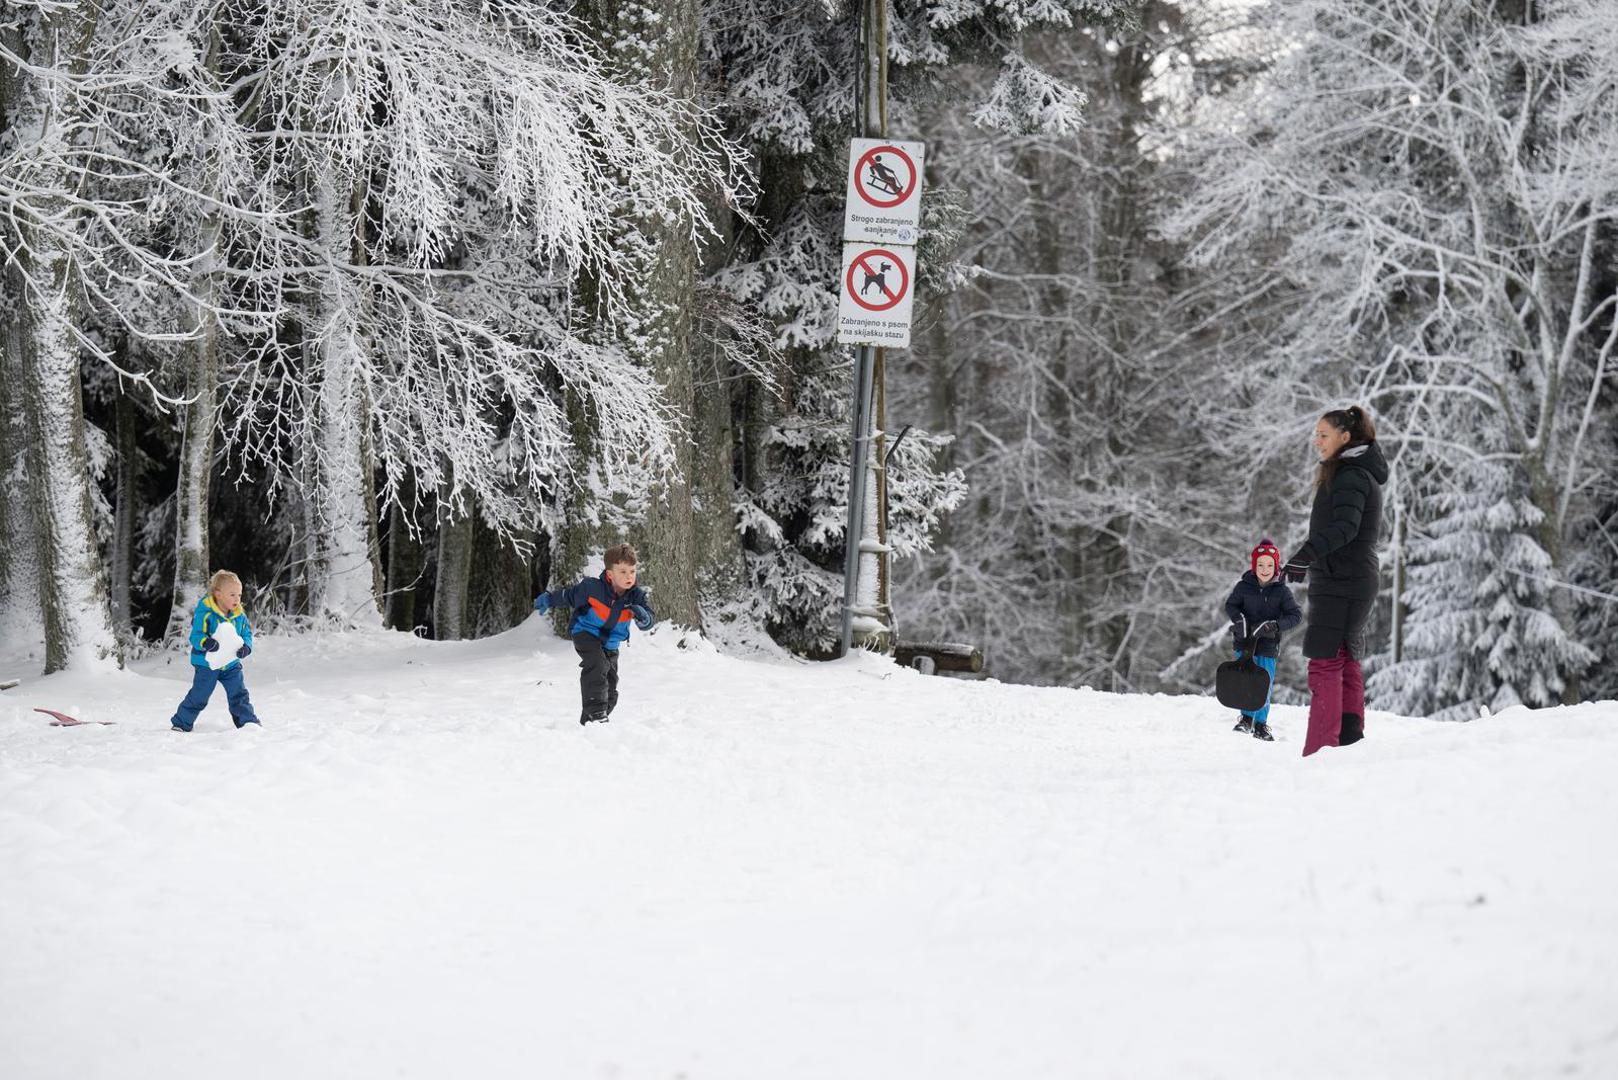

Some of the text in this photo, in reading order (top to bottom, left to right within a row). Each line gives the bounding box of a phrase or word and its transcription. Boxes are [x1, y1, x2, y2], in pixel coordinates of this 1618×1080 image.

[851, 214, 913, 226] Strogo zabranjeno
[841, 317, 881, 327] Zabranjeno
[854, 329, 883, 338] skijašku
